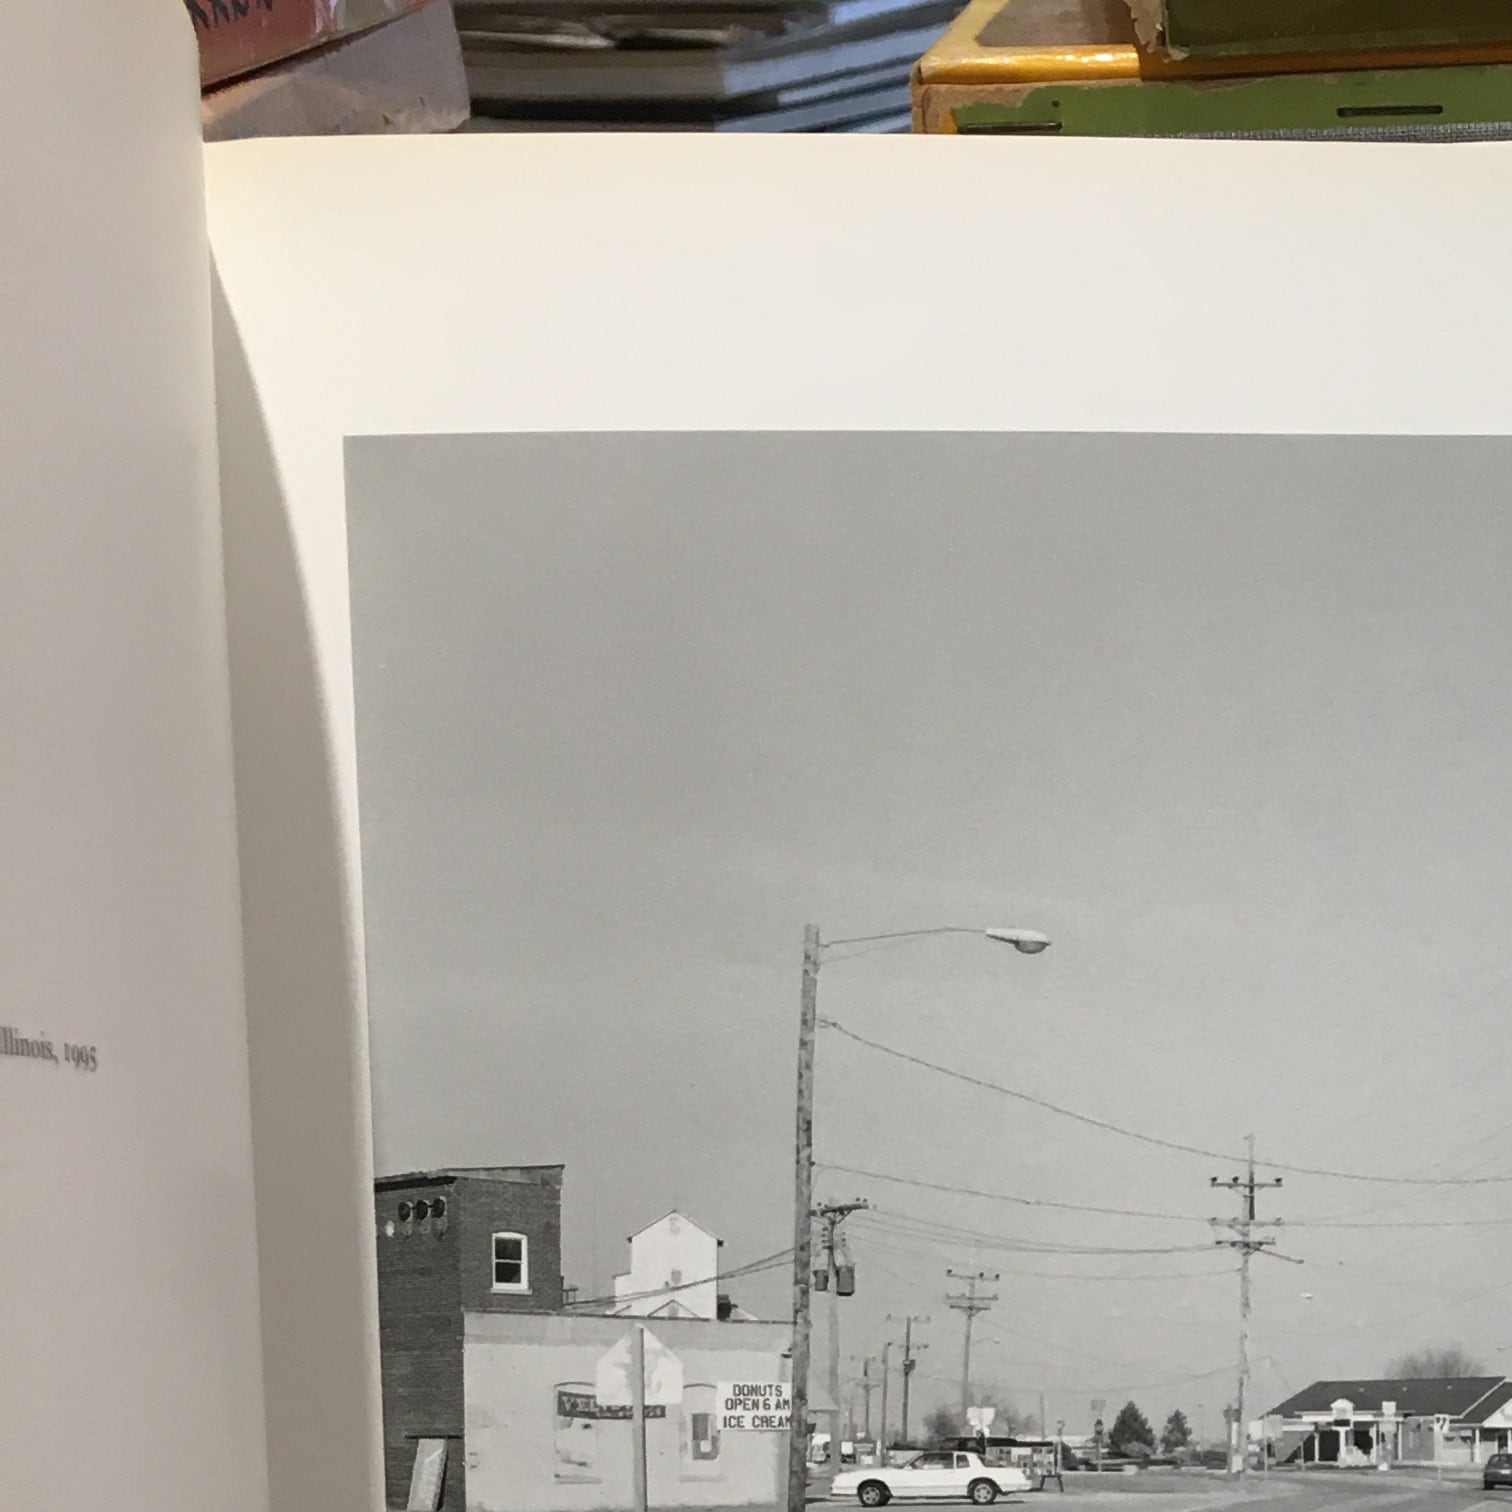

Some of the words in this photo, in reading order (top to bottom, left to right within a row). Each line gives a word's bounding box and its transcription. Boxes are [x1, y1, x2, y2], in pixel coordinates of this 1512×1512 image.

[64, 1043, 98, 1073] 1995
[733, 1384, 783, 1397] DONUTS
[725, 1398, 760, 1411] OPEN
[762, 1397, 771, 1411] 6
[775, 1398, 791, 1411] AM
[723, 1415, 746, 1428] ICE
